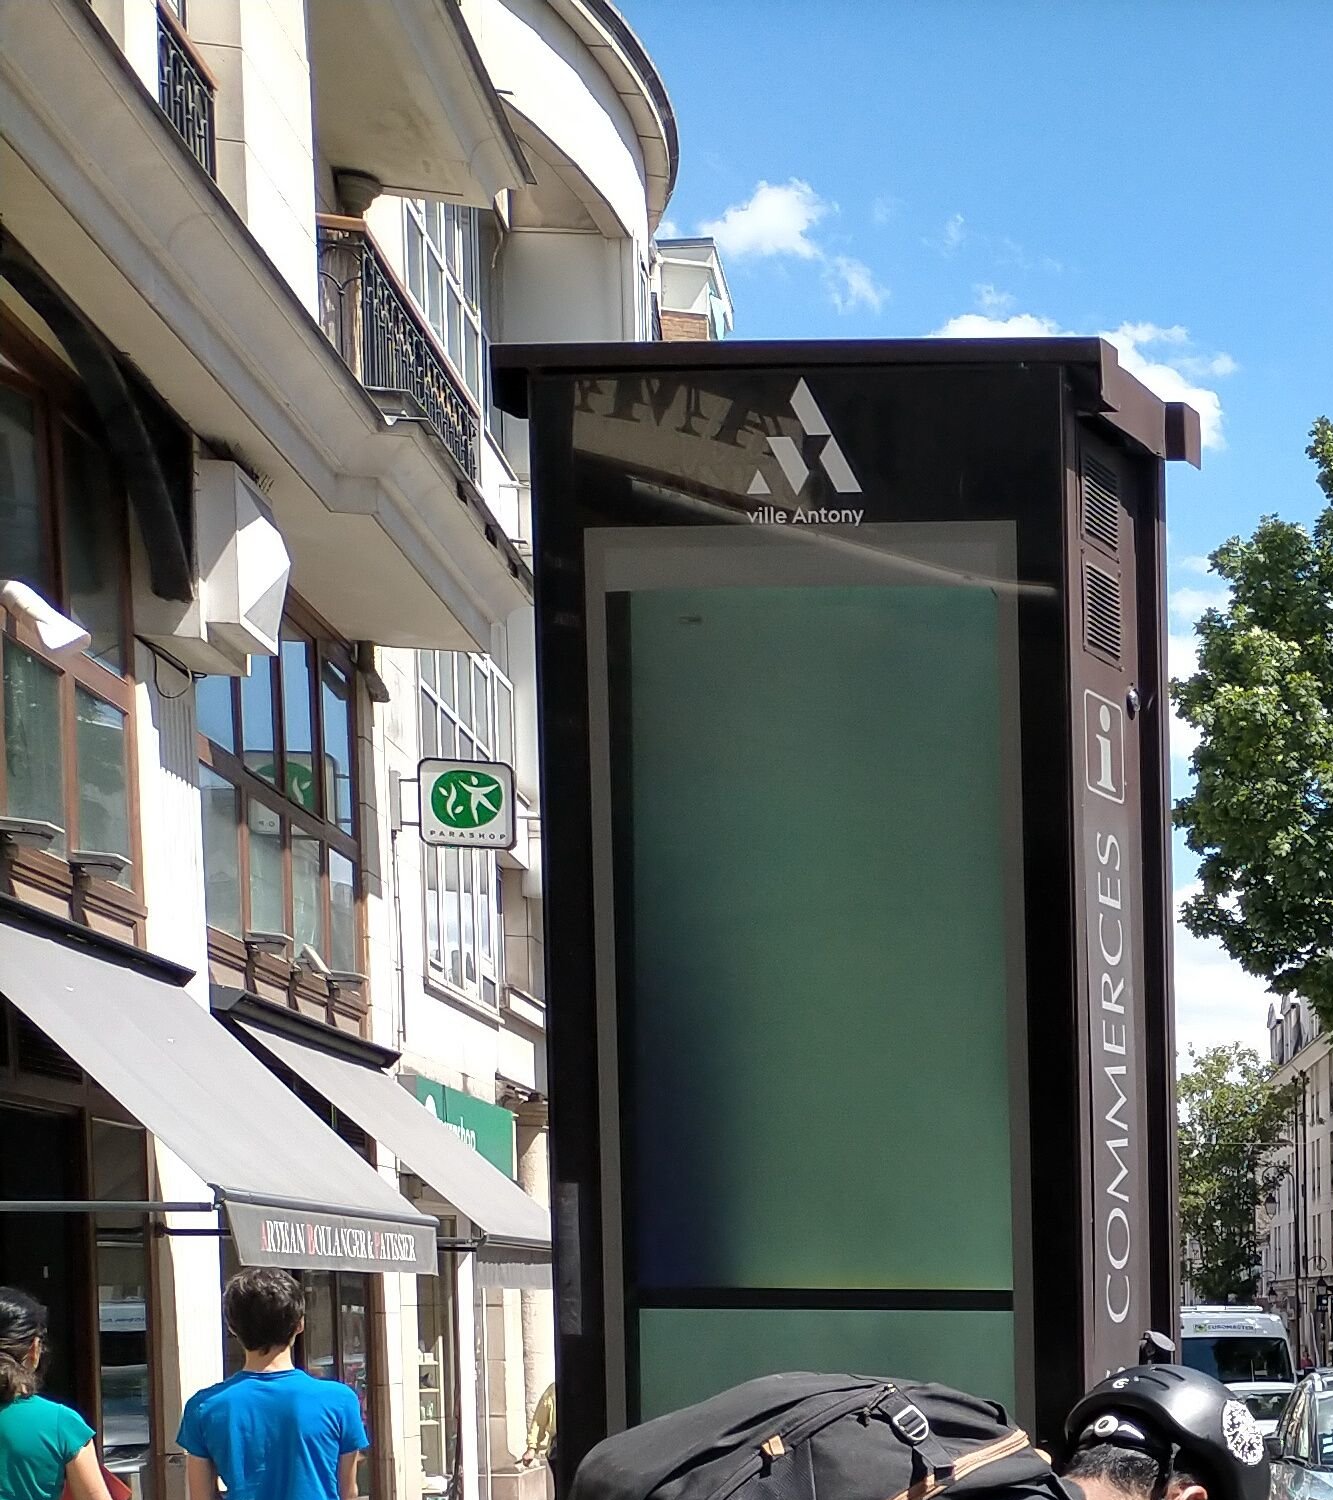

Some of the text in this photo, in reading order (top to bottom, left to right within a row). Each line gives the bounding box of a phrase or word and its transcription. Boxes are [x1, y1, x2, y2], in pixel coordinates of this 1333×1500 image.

[747, 506, 865, 527] ville Antony
[430, 830, 506, 840] PARASHOP
[1096, 831, 1131, 1324] COMMERCES
[261, 1219, 306, 1255] ARTISAN
[306, 1223, 369, 1259] BOULANGER
[373, 1230, 417, 1263] PATISSIER
